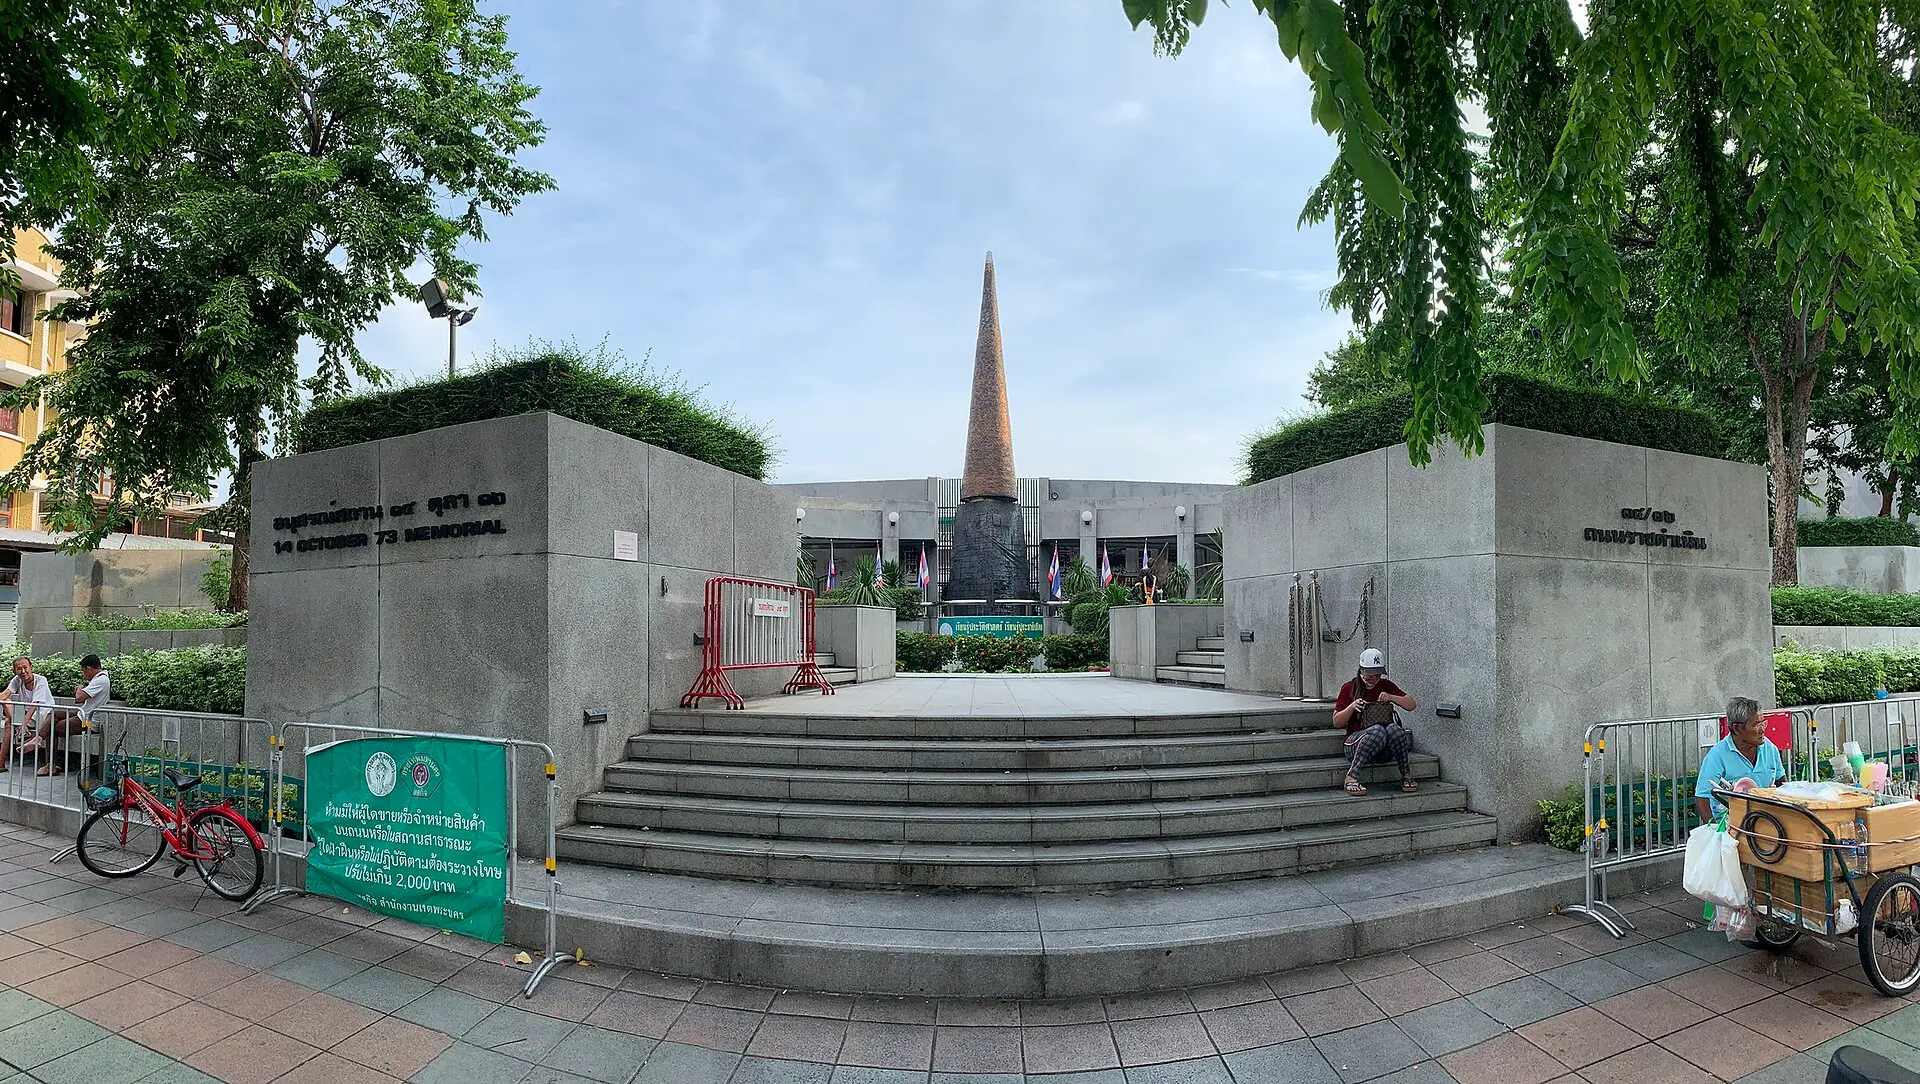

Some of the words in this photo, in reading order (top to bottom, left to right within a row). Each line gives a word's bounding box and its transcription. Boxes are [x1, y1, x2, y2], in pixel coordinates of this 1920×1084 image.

[273, 500, 384, 533] อนุสรณ์สถาน
[427, 493, 470, 516] ตุลา
[273, 540, 293, 554] 14
[297, 533, 367, 552] OCTOBER
[374, 530, 397, 545] 73
[405, 519, 506, 542] MEMORIAL
[1584, 527, 1707, 549] ถนนราชดำเนิน
[334, 824, 472, 851] บนถนนหรือในสถานสาธารณะ
[344, 863, 392, 886] ปรับไม่เกิน
[396, 873, 431, 890] 2,000
[433, 880, 456, 893] บาท
